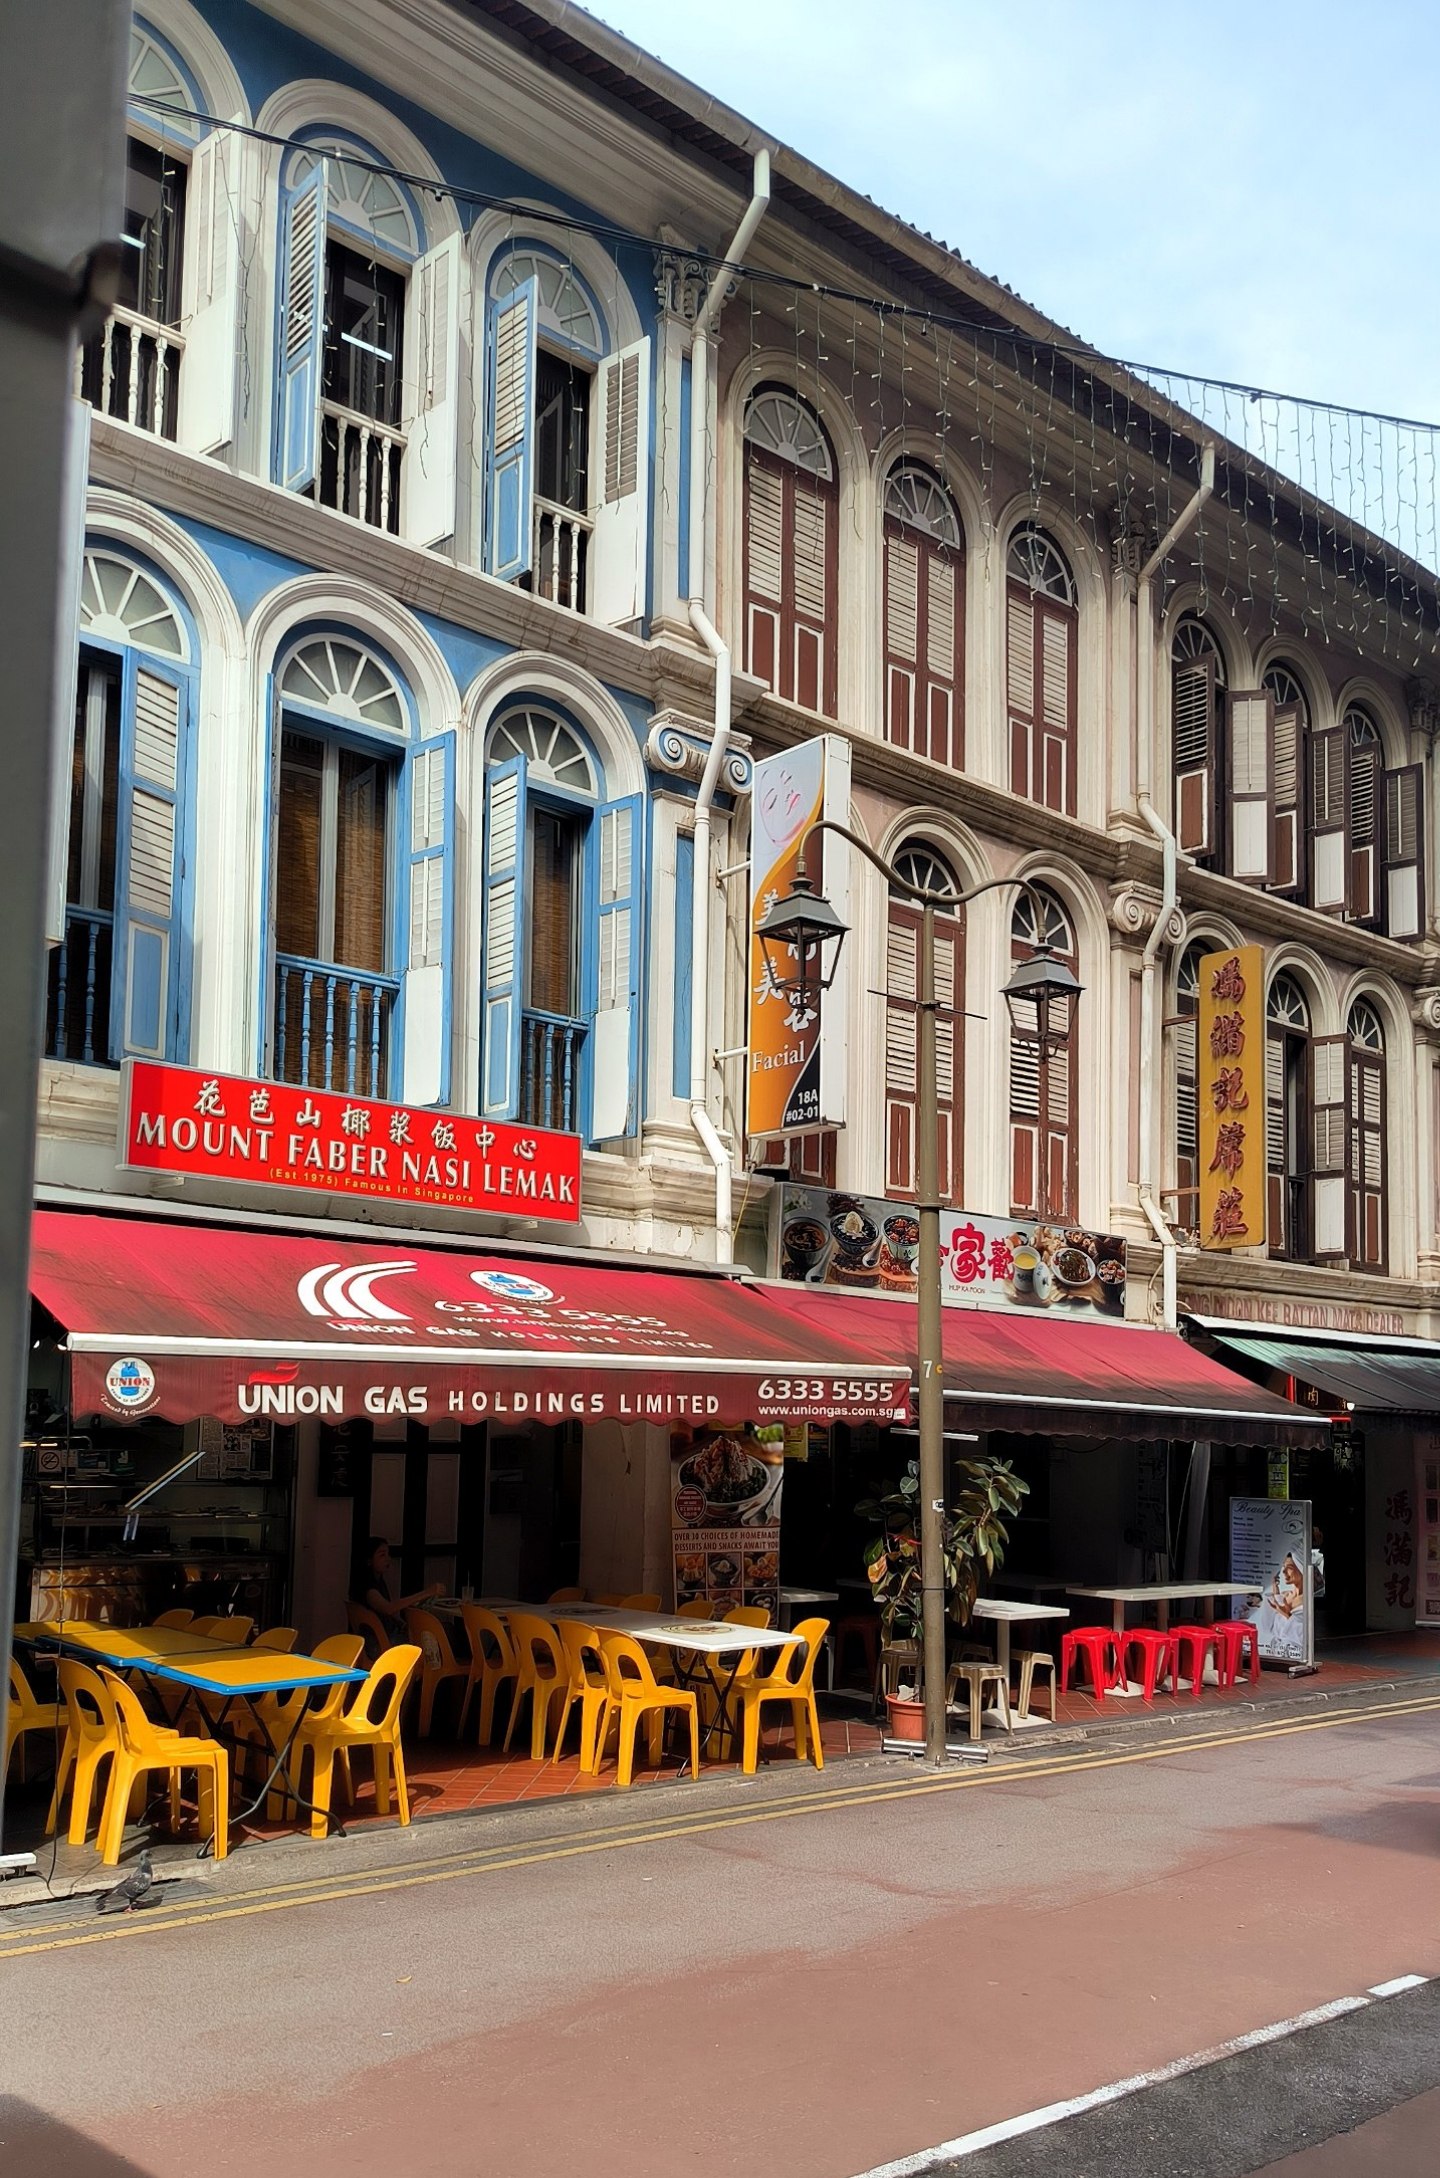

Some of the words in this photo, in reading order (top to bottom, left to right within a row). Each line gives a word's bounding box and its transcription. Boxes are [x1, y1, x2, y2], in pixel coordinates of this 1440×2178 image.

[751, 1039, 805, 1073] Facial
[797, 1089, 818, 1105] 18A
[193, 1079, 538, 1161] 花芭山椰浆饭中心
[785, 1105, 819, 1122] #02-01
[136, 1111, 274, 1162] MOUNT
[287, 1133, 389, 1179] FABER
[401, 1150, 471, 1190] NASI
[483, 1163, 576, 1204] LEMAK
[303, 1172, 338, 1187] 1975)
[344, 1177, 391, 1192] Famous
[414, 1187, 474, 1203] Singapore
[434, 1300, 551, 1318] 6333
[558, 1308, 668, 1327] 5555
[1365, 1310, 1404, 1335] DEALER
[326, 1320, 416, 1335] UNION
[426, 1326, 481, 1337] GAS
[491, 1331, 621, 1344] HOLDINGS
[628, 1338, 714, 1349] LIMITED
[923, 1361, 933, 1379] 7
[110, 1377, 150, 1387] UNION
[757, 1379, 825, 1400] 6333
[831, 1382, 894, 1402] 5555
[238, 1385, 344, 1414] UNION
[364, 1386, 428, 1414] GAS
[449, 1390, 605, 1413] HOLDINGS
[620, 1394, 720, 1414] LIMITED
[758, 1405, 895, 1418] www.uniongas.com.sg
[1233, 1501, 1275, 1520] Beauty
[1278, 1503, 1301, 1521] Spa
[674, 1532, 690, 1541] OVER
[700, 1531, 728, 1541] CHOICES
[730, 1531, 738, 1540] OF
[674, 1542, 702, 1551] DESSERTS
[703, 1542, 717, 1550] AND
[718, 1541, 742, 1550] SNACKS
[743, 1541, 766, 1550] AWAIT
